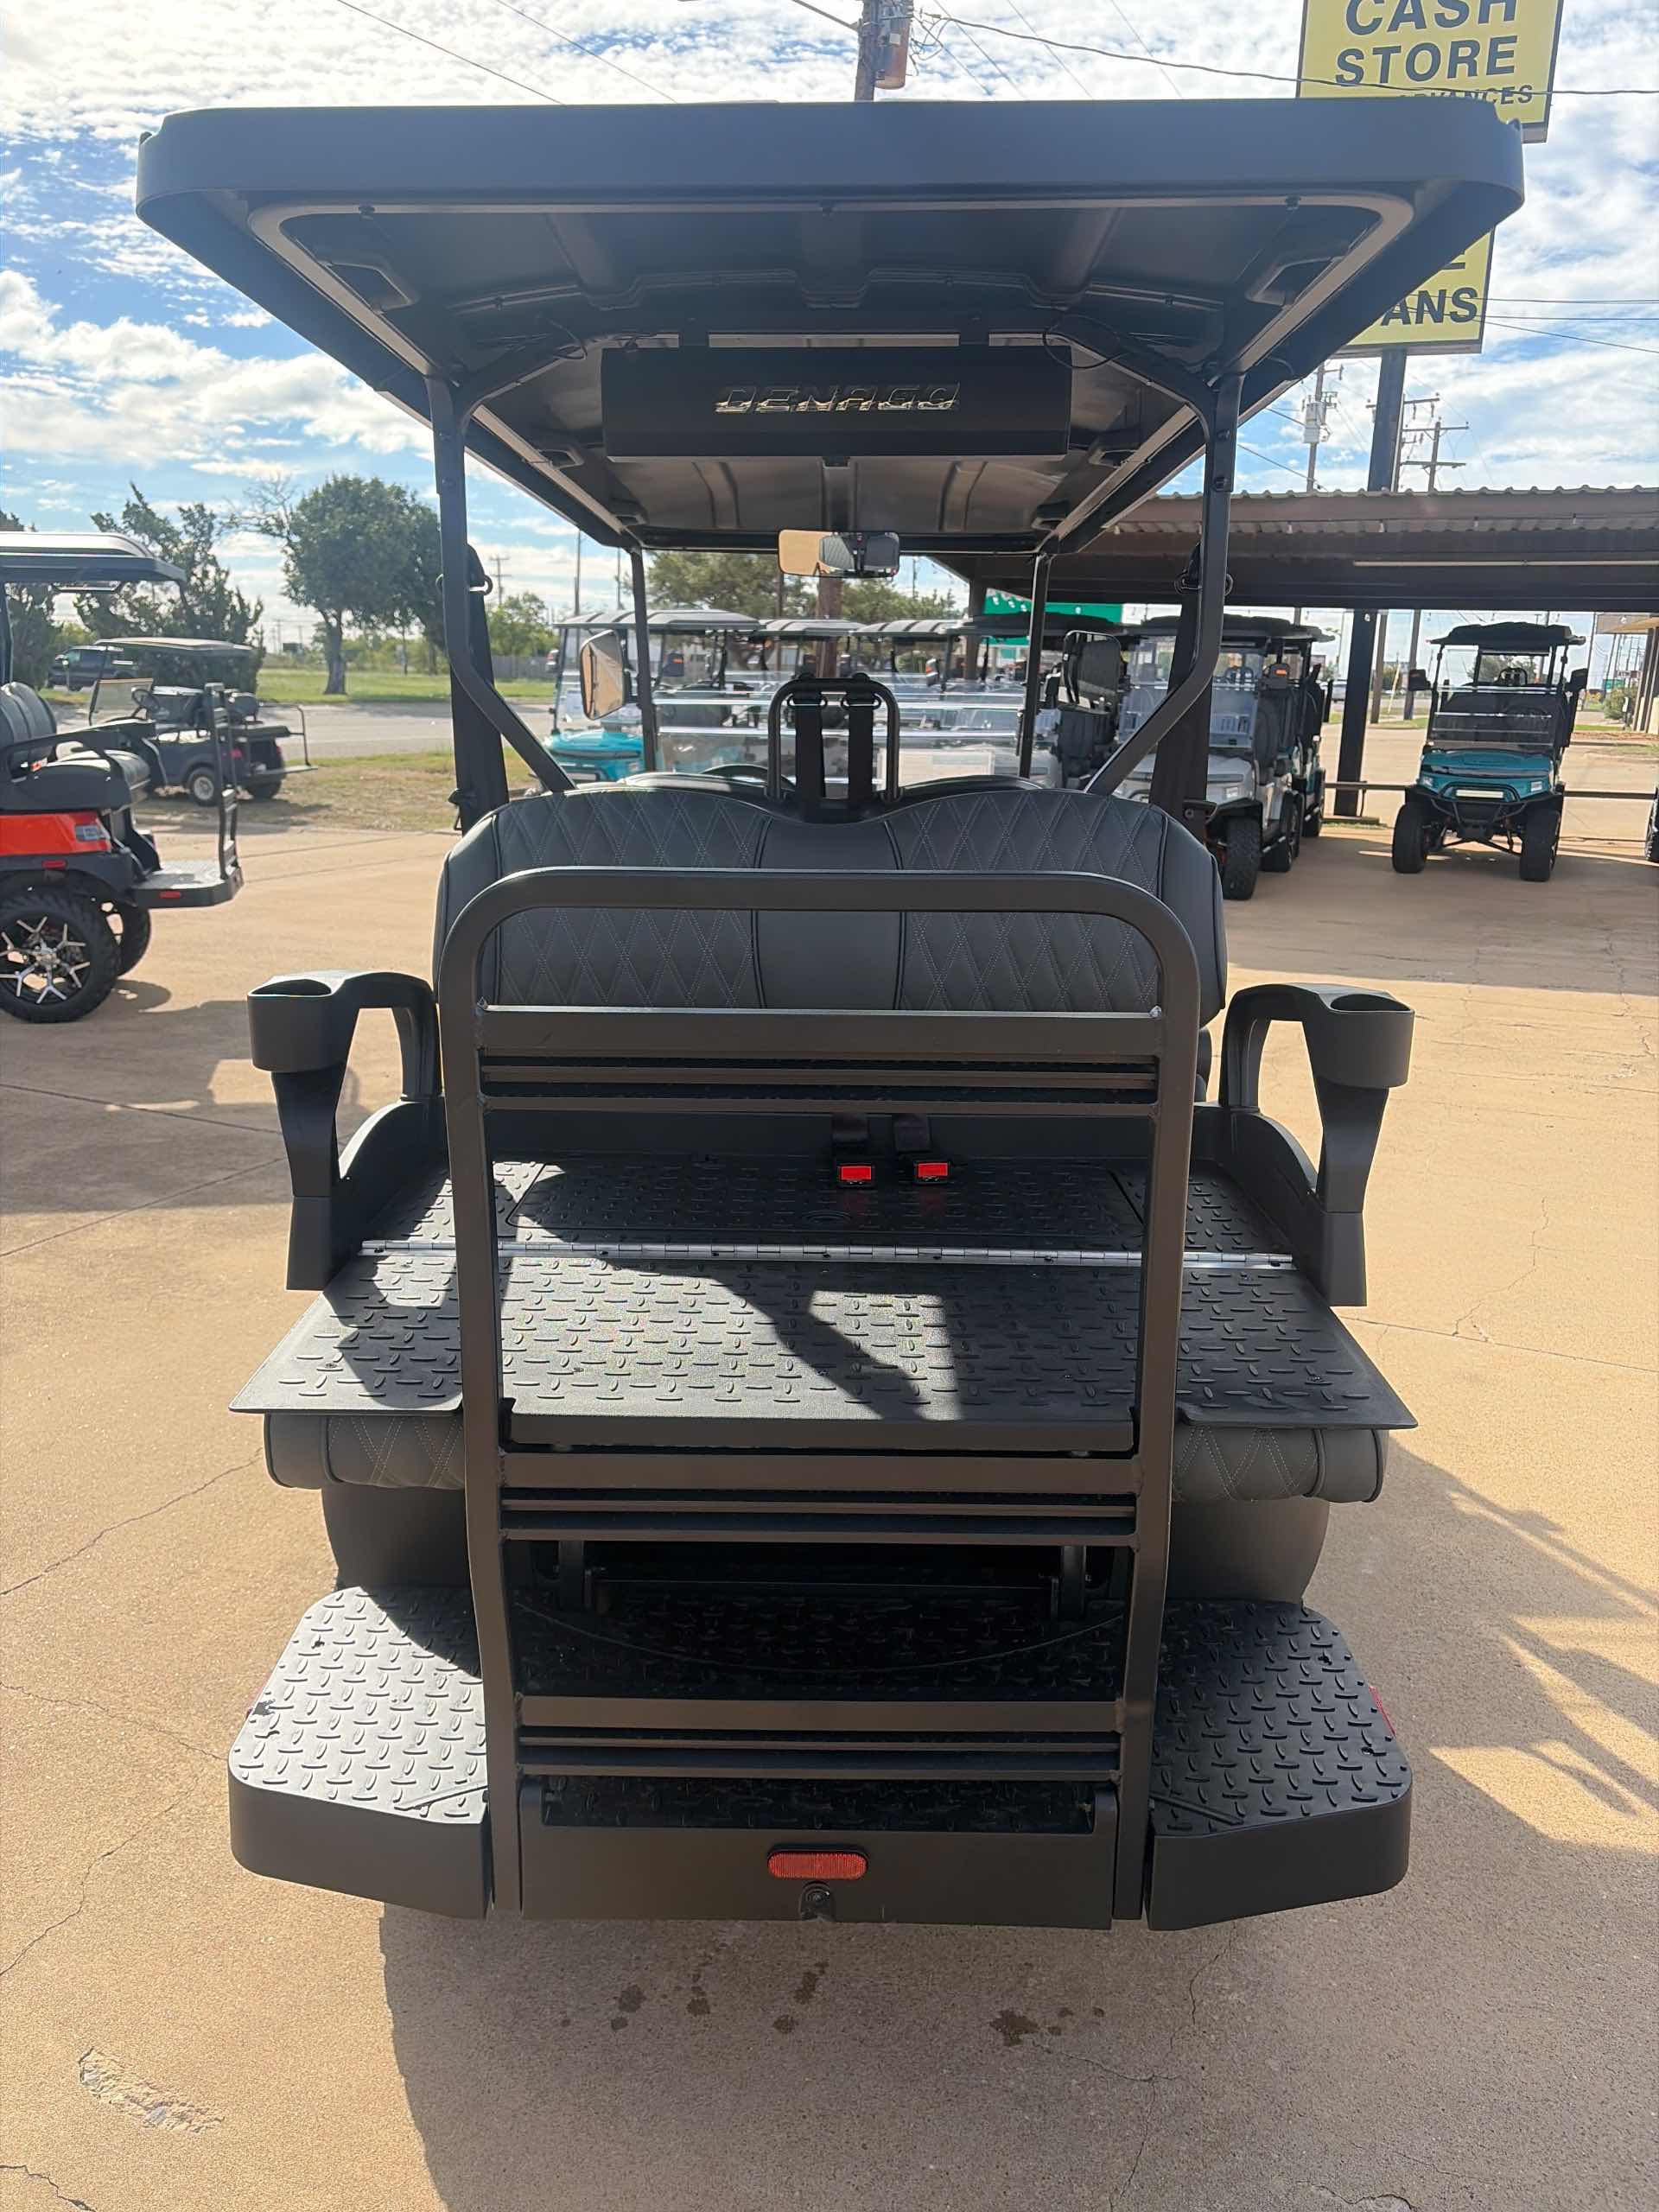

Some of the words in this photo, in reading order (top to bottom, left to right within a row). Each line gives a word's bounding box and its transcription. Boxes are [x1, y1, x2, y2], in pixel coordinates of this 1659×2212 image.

[1345, 0, 1516, 35] CASH
[1335, 35, 1517, 86] STORE
[1381, 287, 1478, 326] ANS
[715, 385, 960, 412] DENAGO
